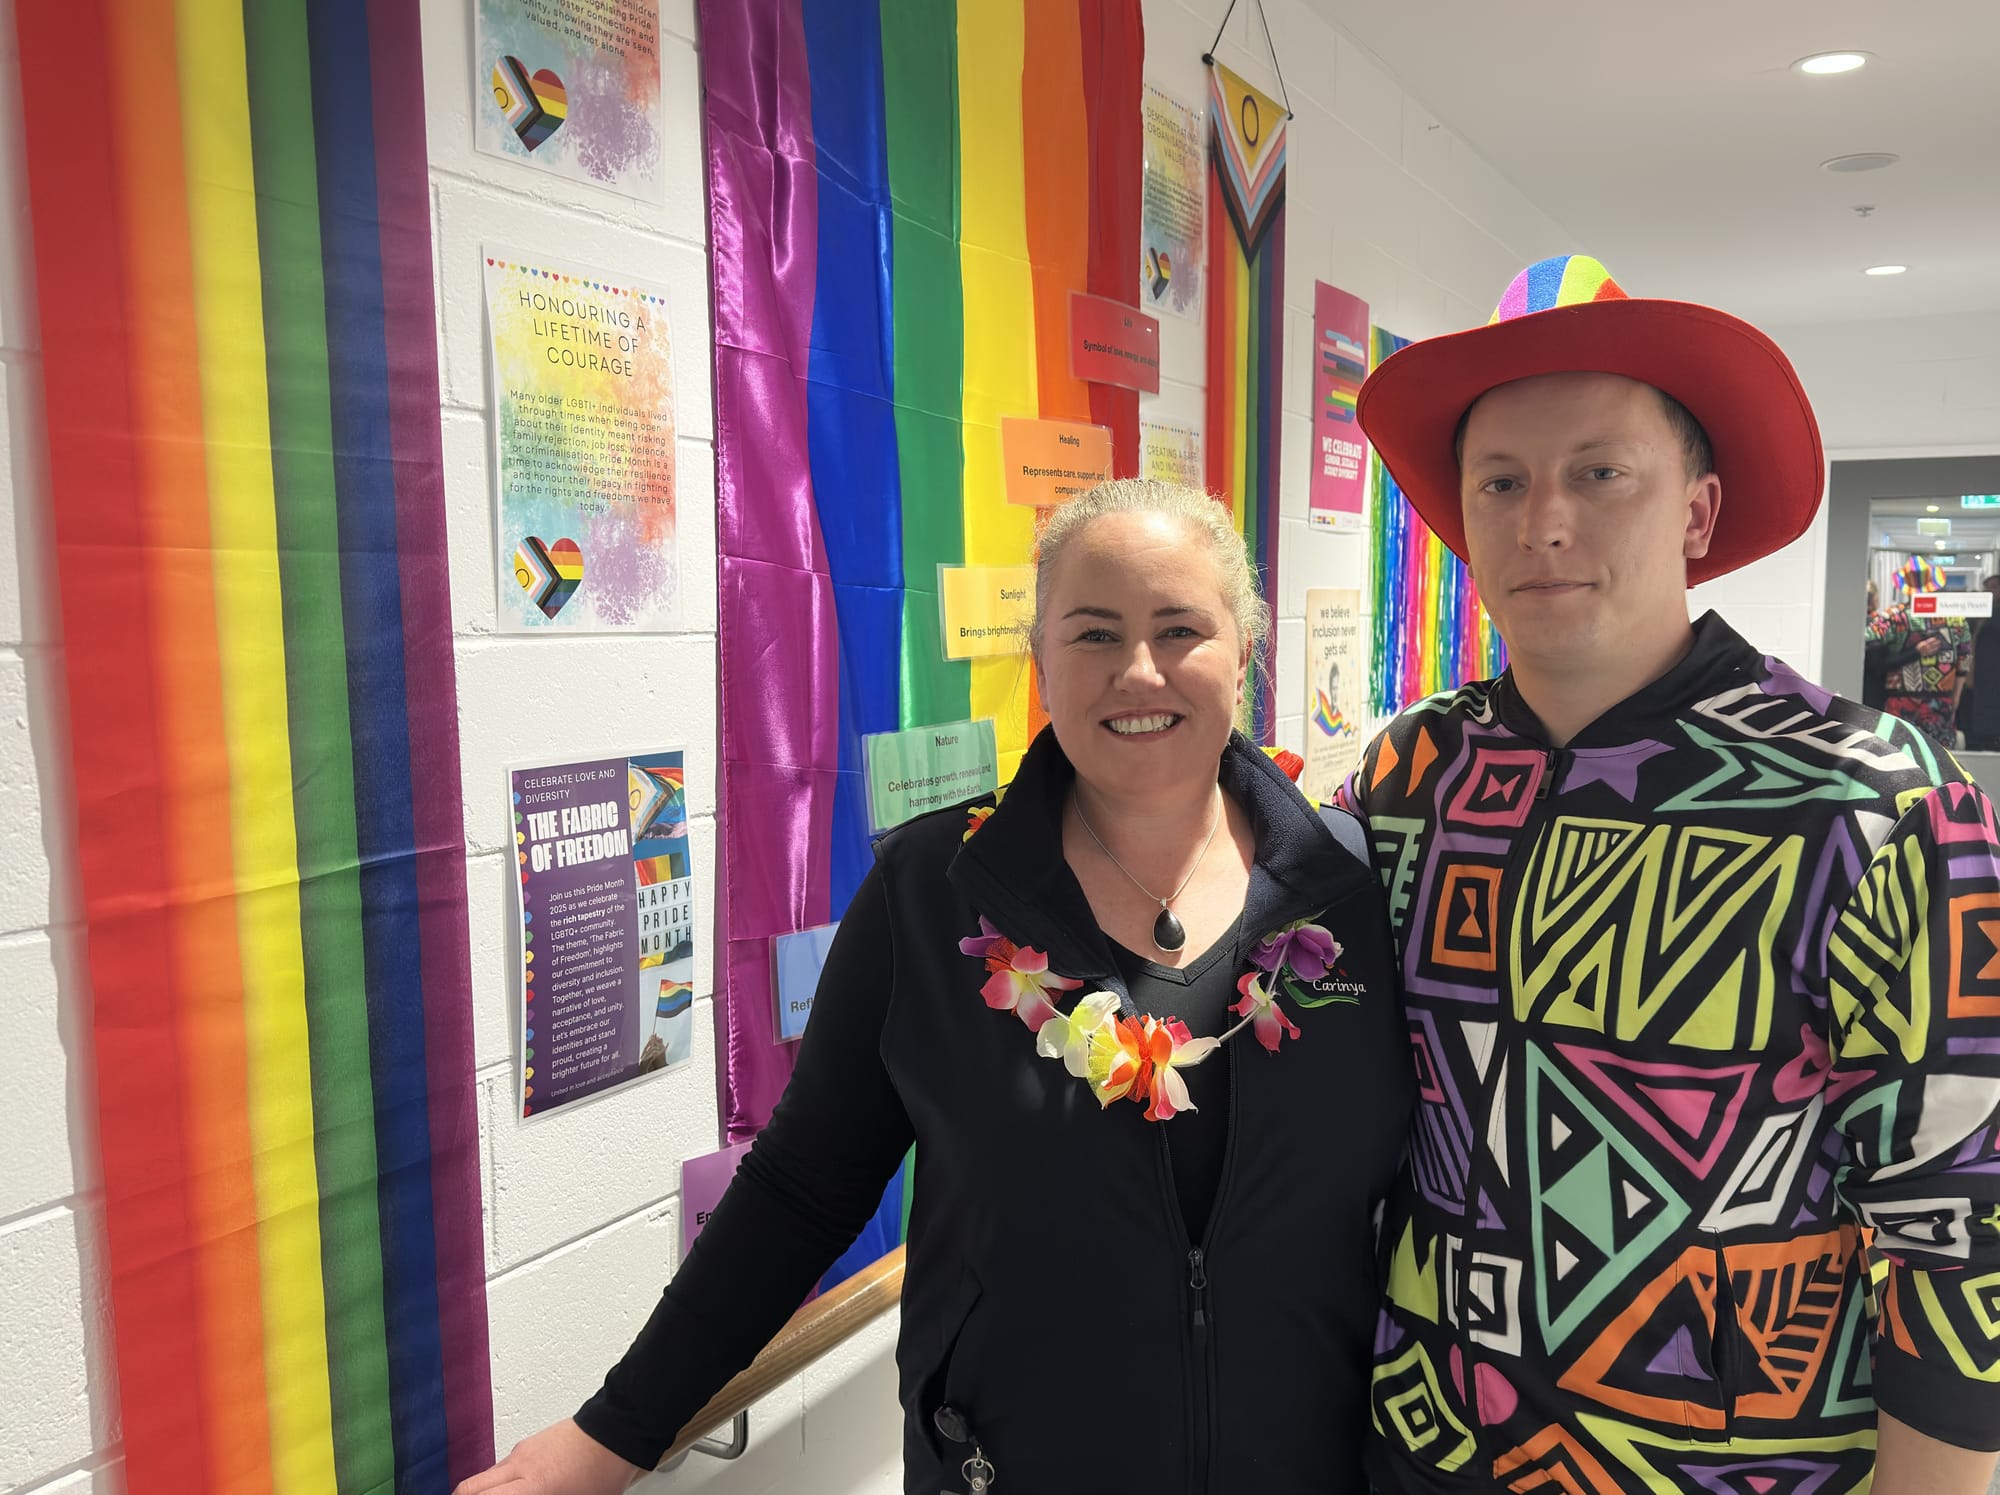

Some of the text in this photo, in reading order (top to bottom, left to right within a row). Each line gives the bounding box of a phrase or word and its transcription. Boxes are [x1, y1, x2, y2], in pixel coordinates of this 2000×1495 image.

[526, 11, 600, 47] valued, and not
[553, 8, 591, 30] showing
[593, 25, 613, 41] they
[616, 36, 631, 46] are
[587, 10, 655, 44] connection and
[630, 12, 652, 29] Pride
[519, 292, 646, 331] HONOURING A
[533, 319, 638, 353] LIFETIME OF
[1083, 339, 1106, 352] Symbol
[547, 347, 632, 376] COURAGE
[510, 391, 667, 421] Many older LGBTI+ individuals lived
[519, 405, 662, 434] through times when being open
[513, 431, 542, 444] family
[544, 435, 589, 449] rejection,
[592, 440, 606, 450] job
[607, 443, 627, 453] loss,
[514, 418, 666, 447] about their identity meant risking
[1059, 434, 1080, 447] Healing
[512, 445, 523, 453] or
[525, 445, 595, 460] criminalisation.
[599, 454, 622, 463] Pride
[625, 456, 651, 467] Month
[653, 459, 661, 468] is
[1322, 436, 1362, 460] WE CELEBRATE
[508, 457, 671, 481] time to acknowledge their resilience
[1023, 466, 1063, 479] Represents
[509, 484, 526, 492] for
[527, 485, 542, 494] the
[544, 487, 571, 498] rights
[574, 489, 591, 498] and
[593, 491, 635, 502] freedoms
[652, 496, 671, 505] have
[512, 471, 668, 495] and honour their legacy in fighting
[1000, 590, 1027, 602] Sunlight
[1320, 604, 1350, 618] we believe
[960, 627, 987, 639] Brings
[1312, 624, 1357, 638] inclusion never
[1324, 640, 1347, 659] gets old
[935, 736, 958, 747] Nature
[525, 769, 616, 788] CELEBRATE LOVE AND
[888, 776, 934, 792] Celebrates
[981, 764, 991, 774] and
[526, 791, 570, 803] DIVERSITY
[909, 793, 942, 808] harmony
[943, 790, 956, 802] with
[957, 787, 966, 797] the
[527, 801, 619, 841] THE FABRIC
[530, 829, 629, 873] OF FREEDOM
[549, 893, 563, 901] Join
[574, 888, 586, 896] this
[587, 884, 603, 893] Pride
[605, 879, 625, 889] Month
[638, 882, 690, 908] HAPPY
[550, 905, 567, 914] 2025
[589, 893, 618, 905] celebrate
[563, 915, 577, 924] rich
[578, 909, 606, 922] tapestry
[643, 904, 689, 931] PRIDE
[551, 918, 616, 940] LGBTQ+ community.
[552, 928, 624, 952] The theme, Fabric
[641, 926, 691, 954] MONTH
[552, 941, 624, 966] of highlights
[552, 965, 624, 992] diversity and inclusion.
[565, 959, 605, 975] commitment
[553, 989, 584, 1005] Together,
[597, 981, 617, 990] weave
[1312, 978, 1366, 996] Carinya
[552, 1002, 582, 1016] narrative
[583, 999, 590, 1007] of
[552, 1013, 592, 1030] acceptance,
[594, 1007, 606, 1016] and
[570, 1023, 598, 1036] embrace
[552, 1029, 616, 1054] identities and stand
[552, 1055, 574, 1068] proud,
[576, 1046, 603, 1060] creating
[552, 1065, 579, 1081] brighter
[580, 1058, 600, 1070] future
[602, 1054, 610, 1062] for
